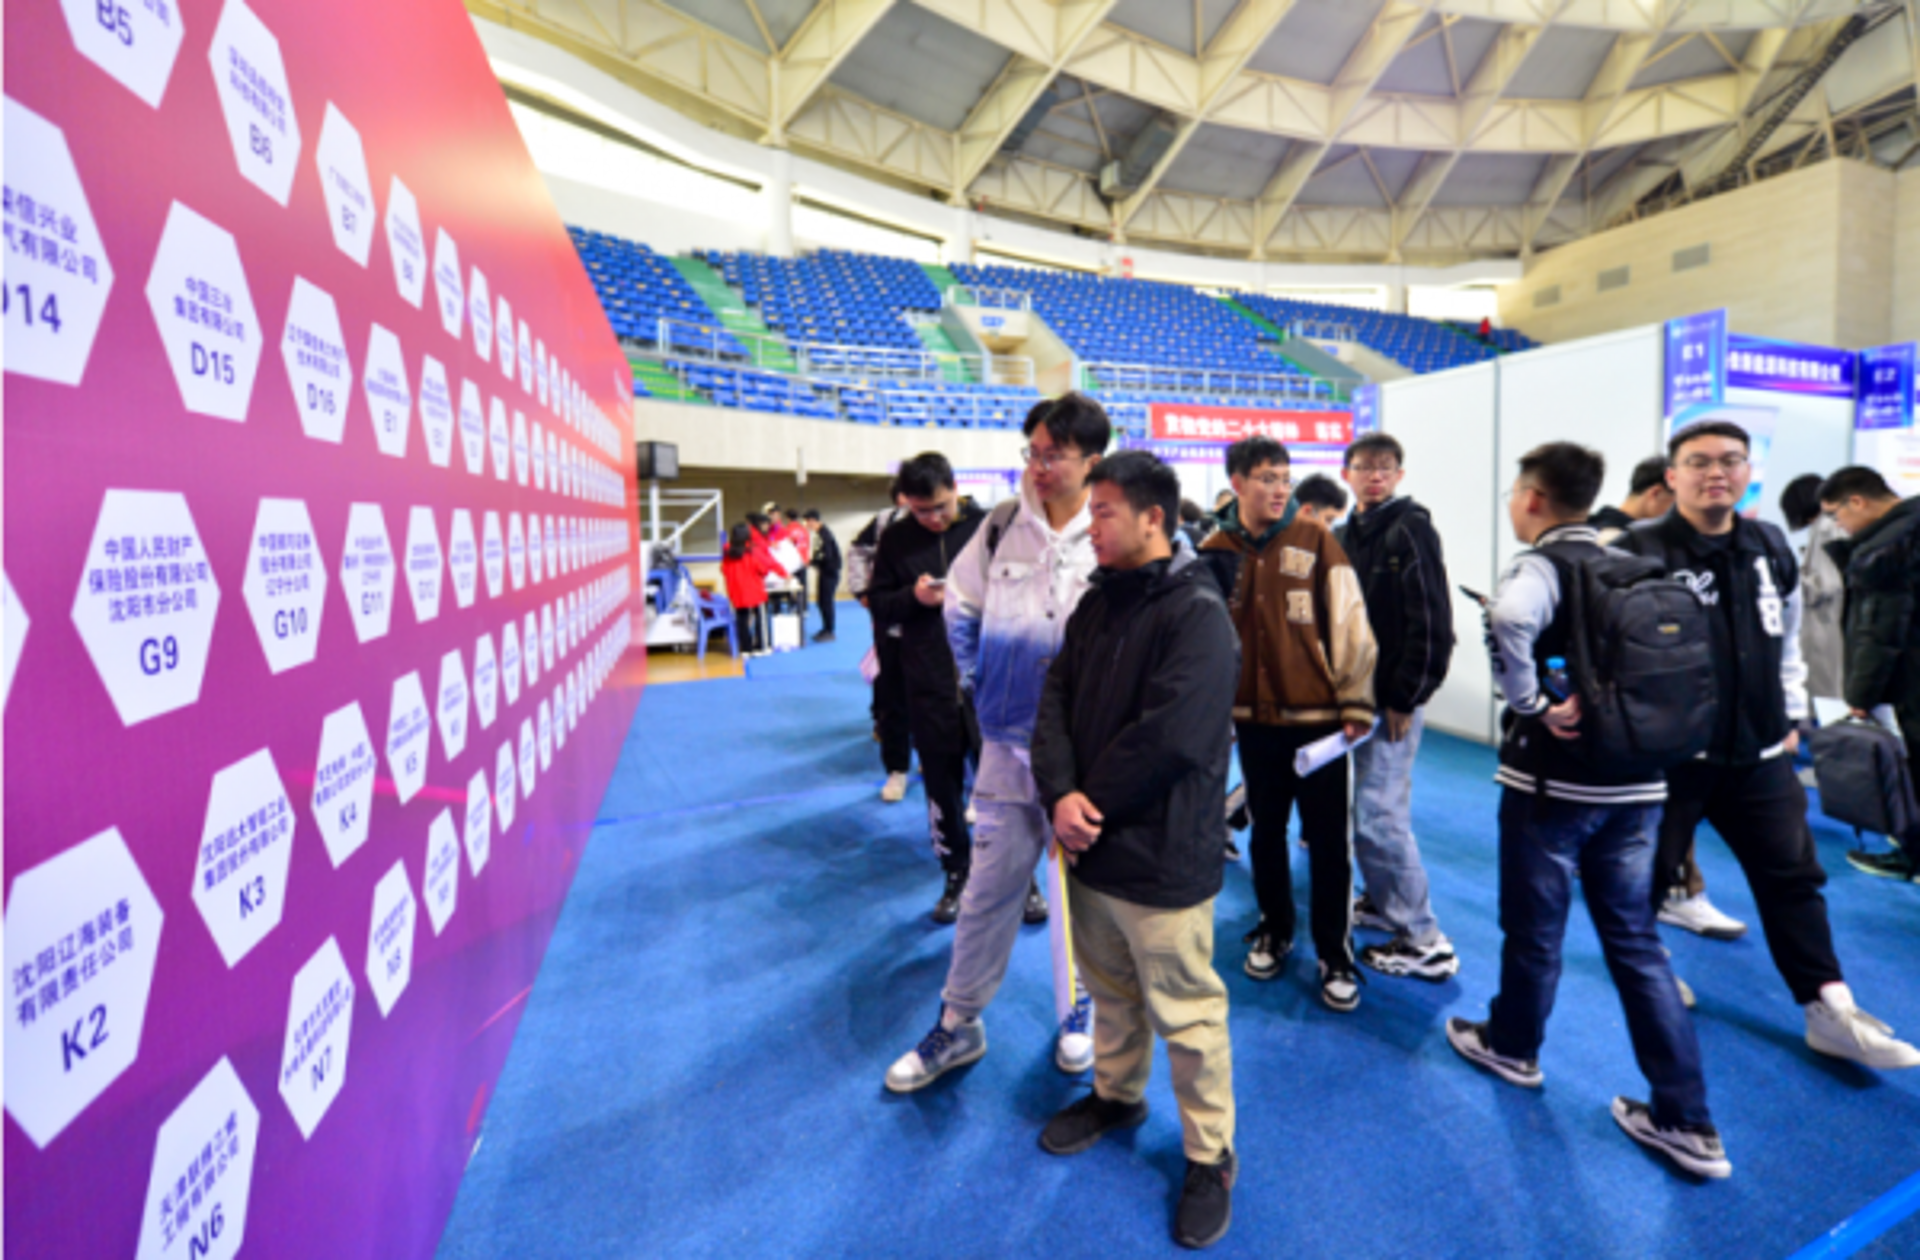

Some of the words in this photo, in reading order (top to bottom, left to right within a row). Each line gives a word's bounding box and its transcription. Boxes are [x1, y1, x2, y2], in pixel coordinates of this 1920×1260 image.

[95, 0, 133, 46] B5
[250, 123, 273, 164] B6
[3, 279, 62, 334] 14
[191, 340, 236, 386] D15
[307, 382, 336, 416] D16
[104, 536, 193, 562] 中国人民财产
[89, 561, 209, 595] 保险股份有限公司
[109, 587, 198, 623] 沈阳市分公司
[274, 606, 308, 639] G10
[139, 635, 180, 676] G9
[239, 875, 266, 919] K3
[13, 897, 131, 997] 沈阳辽海装备
[16, 926, 134, 1029] 有限责任公司
[60, 1003, 109, 1073] K2
[189, 1202, 225, 1260] N6
